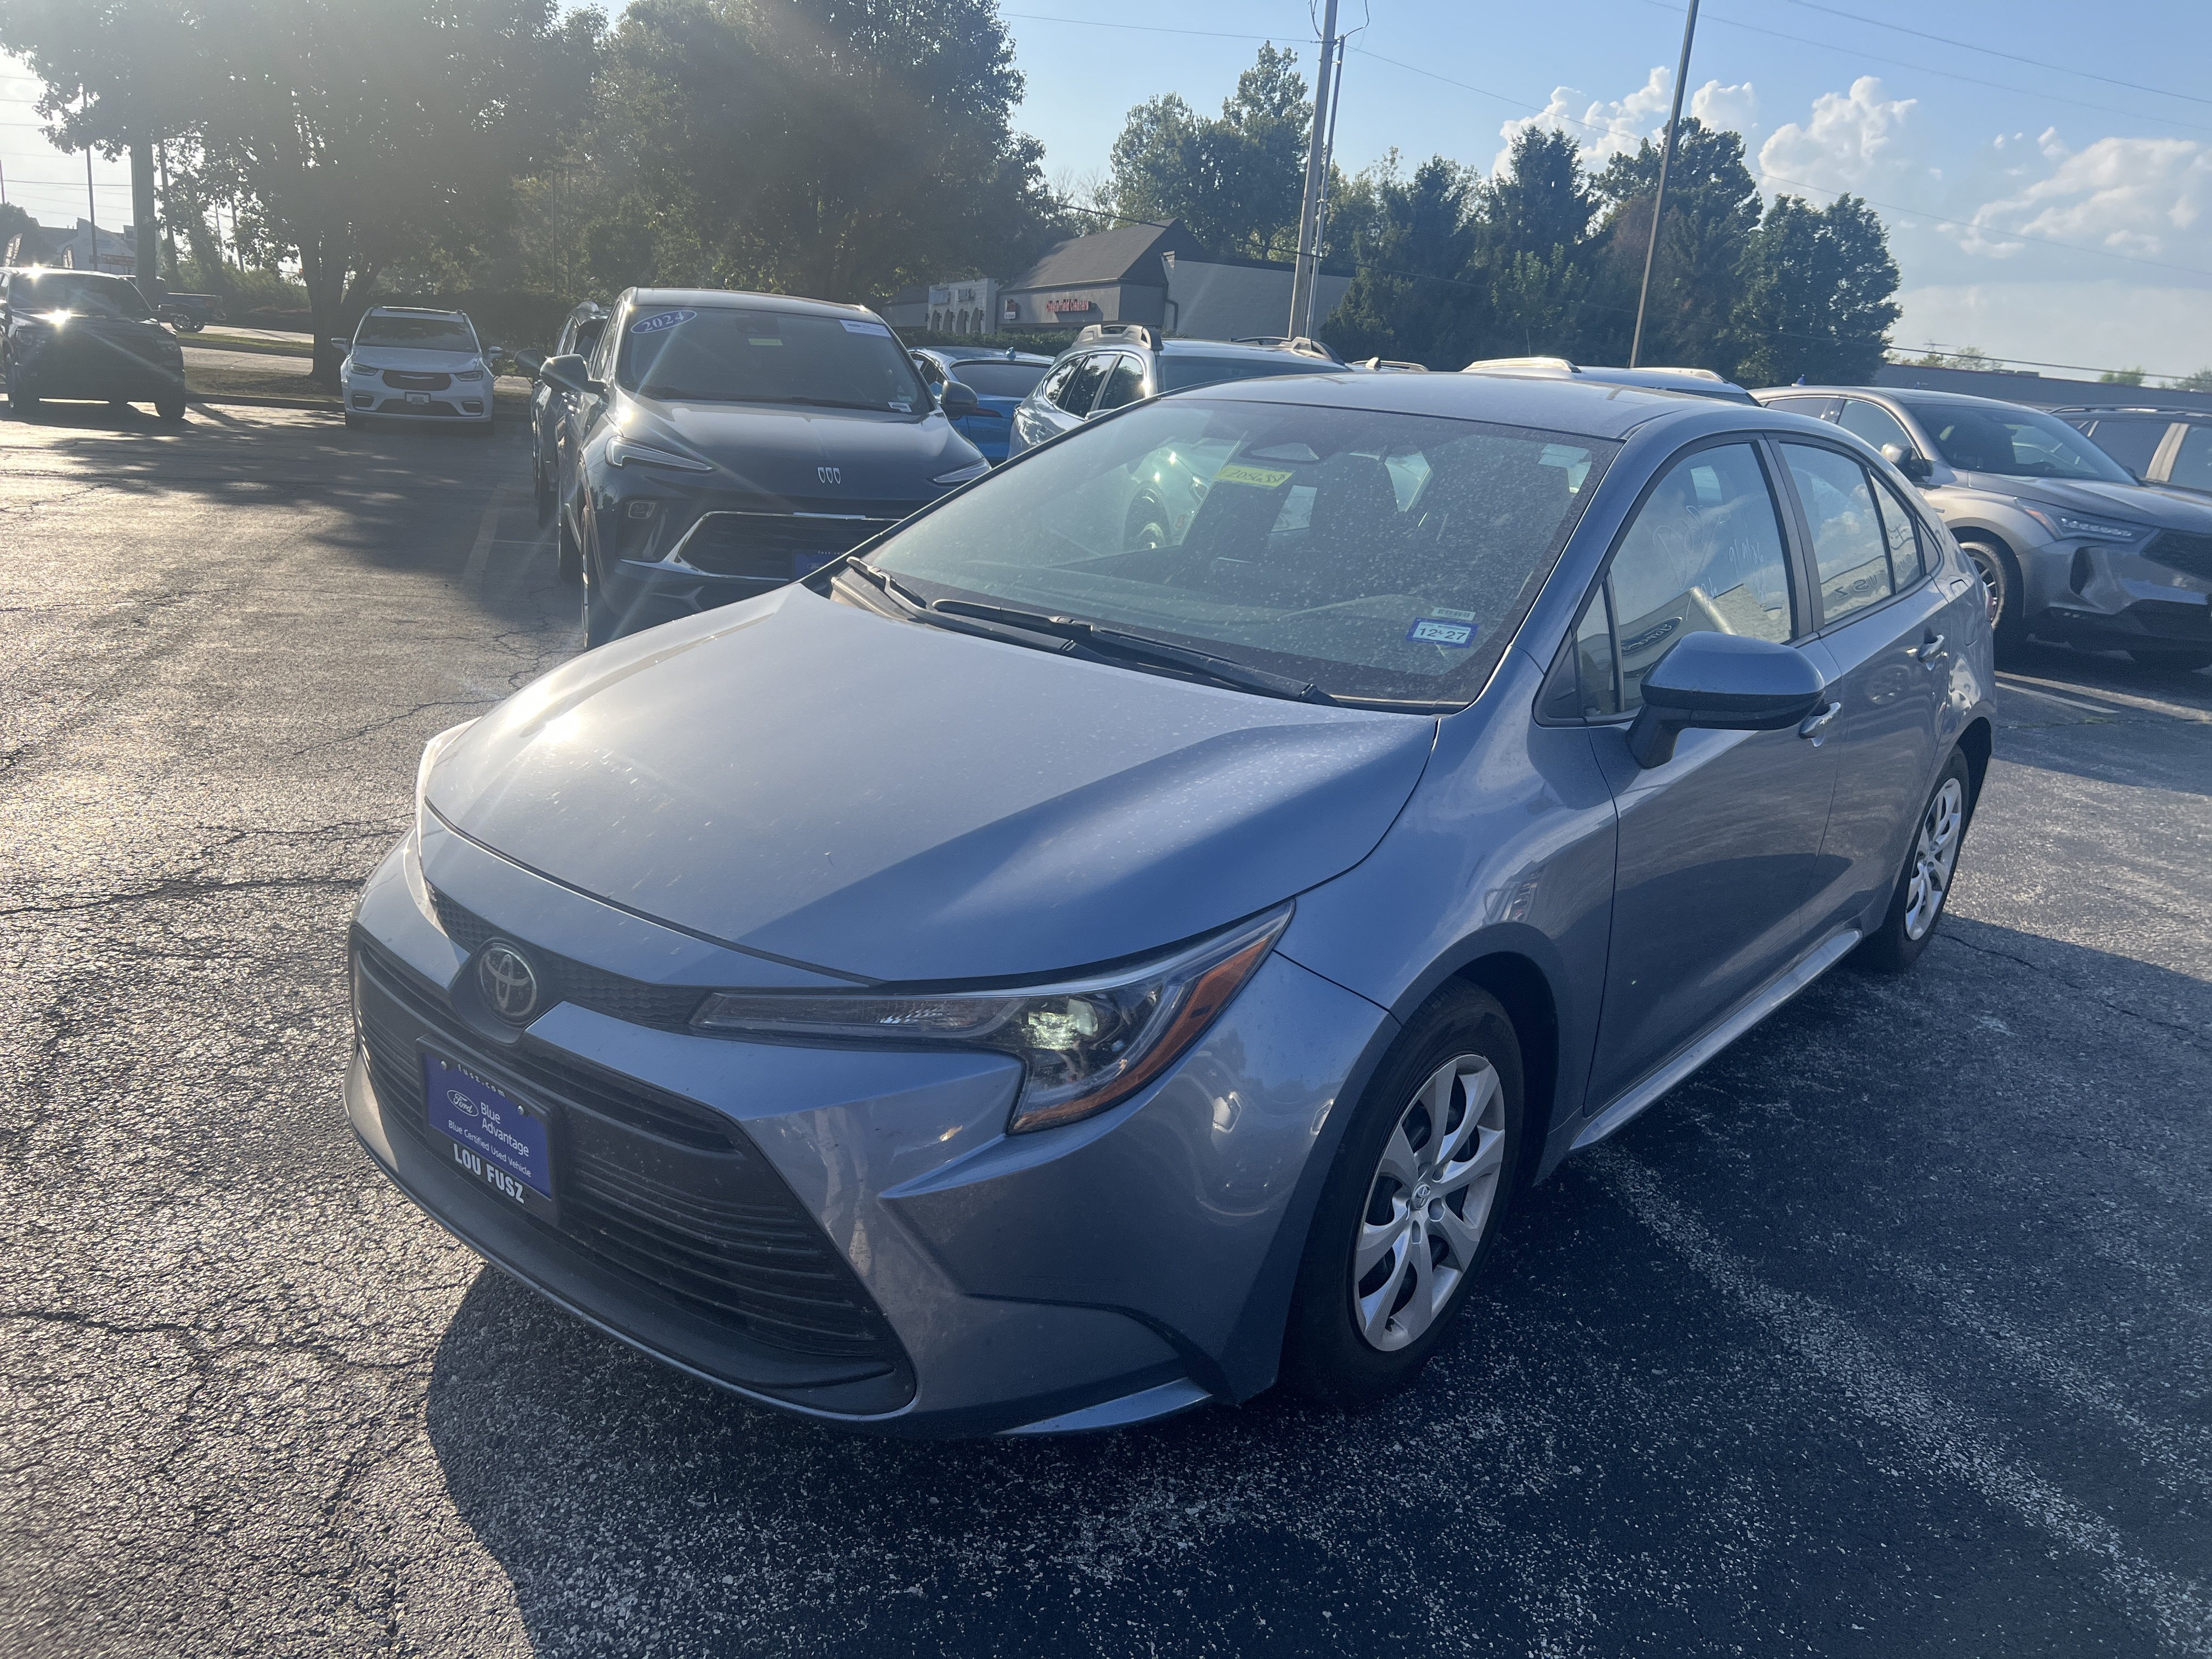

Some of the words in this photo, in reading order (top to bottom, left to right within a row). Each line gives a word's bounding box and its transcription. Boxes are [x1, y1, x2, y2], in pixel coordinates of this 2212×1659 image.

[642, 312, 685, 331] 2024
[1419, 628, 1438, 637] 12
[1444, 631, 1466, 640] 27
[457, 1064, 505, 1097] fusz.com
[453, 1093, 473, 1114] Ford
[481, 1102, 500, 1124] Blue
[448, 1120, 463, 1135] Blue
[464, 1129, 489, 1152] Certified
[491, 1145, 507, 1163] Used
[508, 1156, 531, 1177] Vehicle
[482, 1118, 529, 1157] Advantage
[453, 1143, 482, 1176] LOU
[486, 1164, 524, 1204] FUSZ
